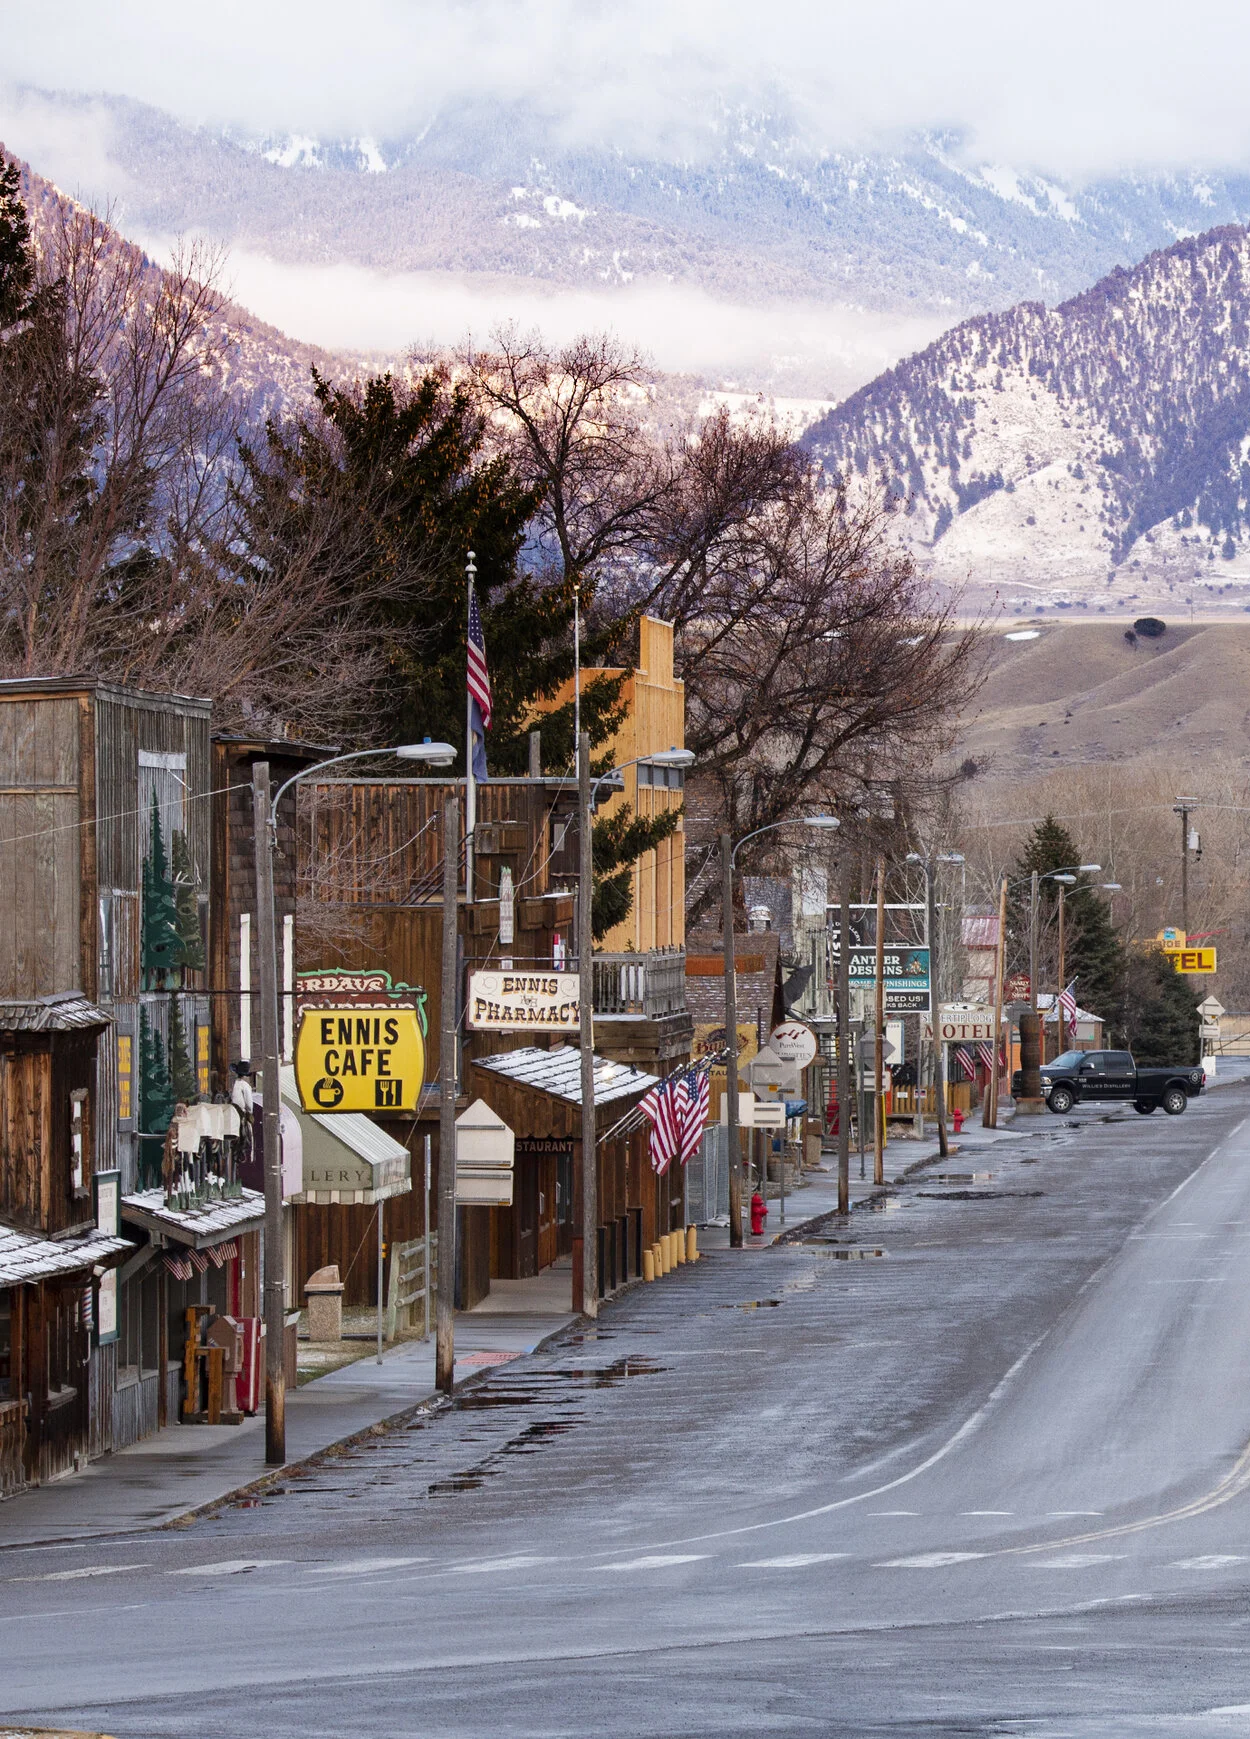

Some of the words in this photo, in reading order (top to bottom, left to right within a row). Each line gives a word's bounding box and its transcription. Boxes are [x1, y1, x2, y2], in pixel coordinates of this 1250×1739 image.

[849, 965, 903, 975] DESINS
[850, 955, 900, 965] ANTER
[502, 977, 558, 995] ENNIS
[474, 997, 580, 1023] PHARMACY
[321, 1017, 399, 1045] ENNIS
[324, 1049, 391, 1076] CAFE
